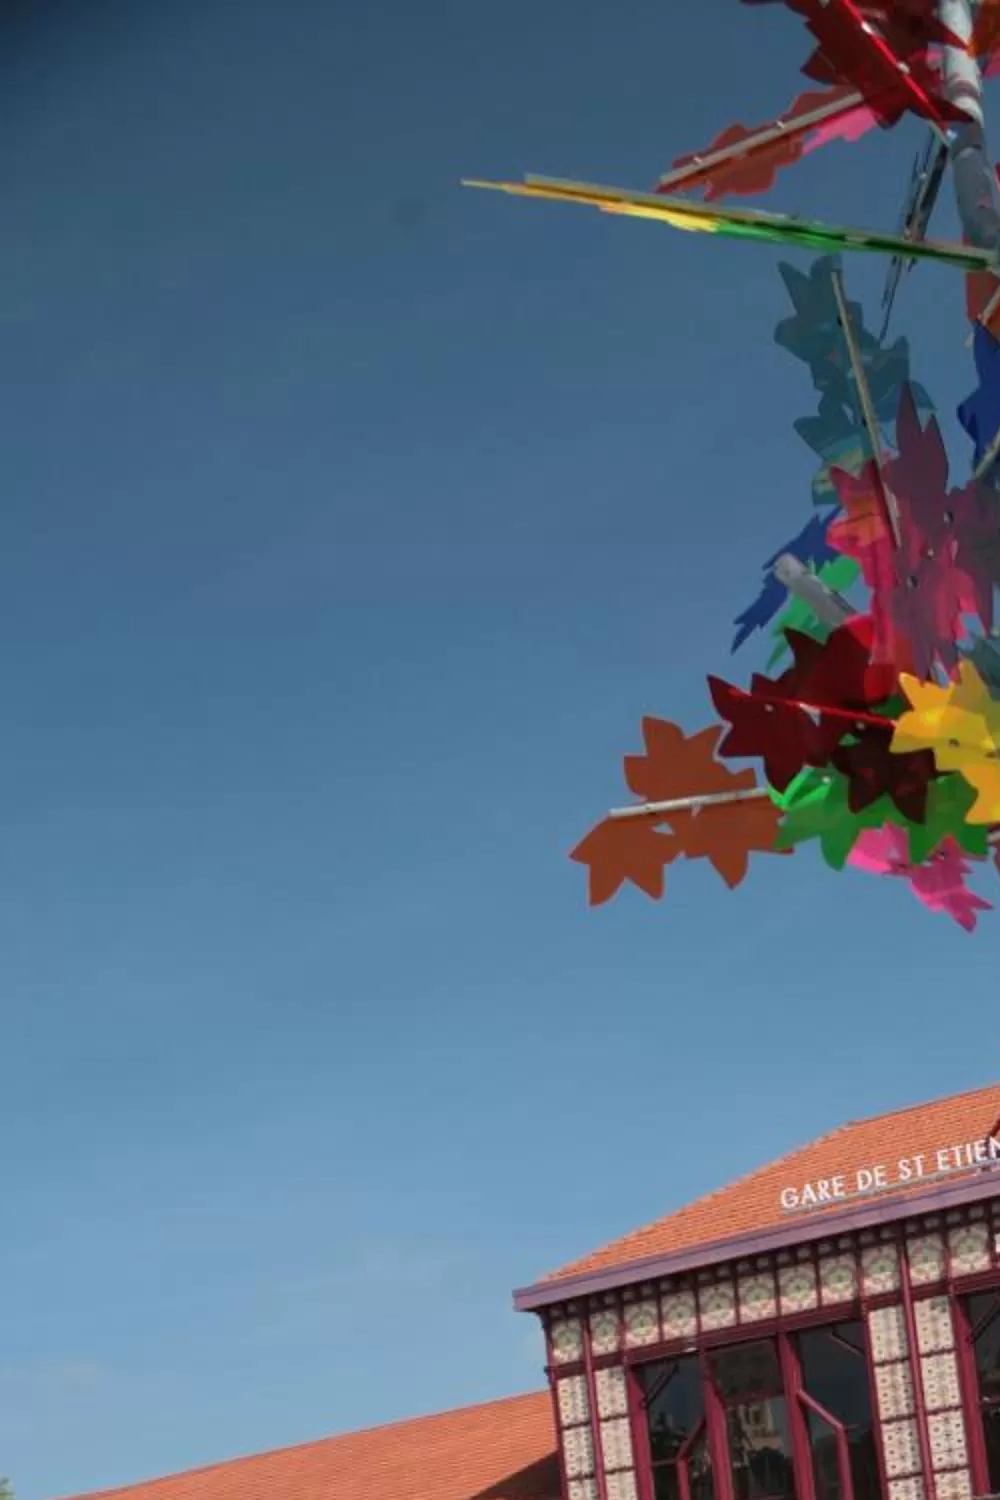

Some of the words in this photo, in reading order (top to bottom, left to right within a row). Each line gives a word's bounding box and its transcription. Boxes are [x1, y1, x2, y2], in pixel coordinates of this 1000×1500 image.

[780, 1174, 847, 1209] GARE
[856, 1165, 888, 1192] DE
[897, 1154, 926, 1181] ST
